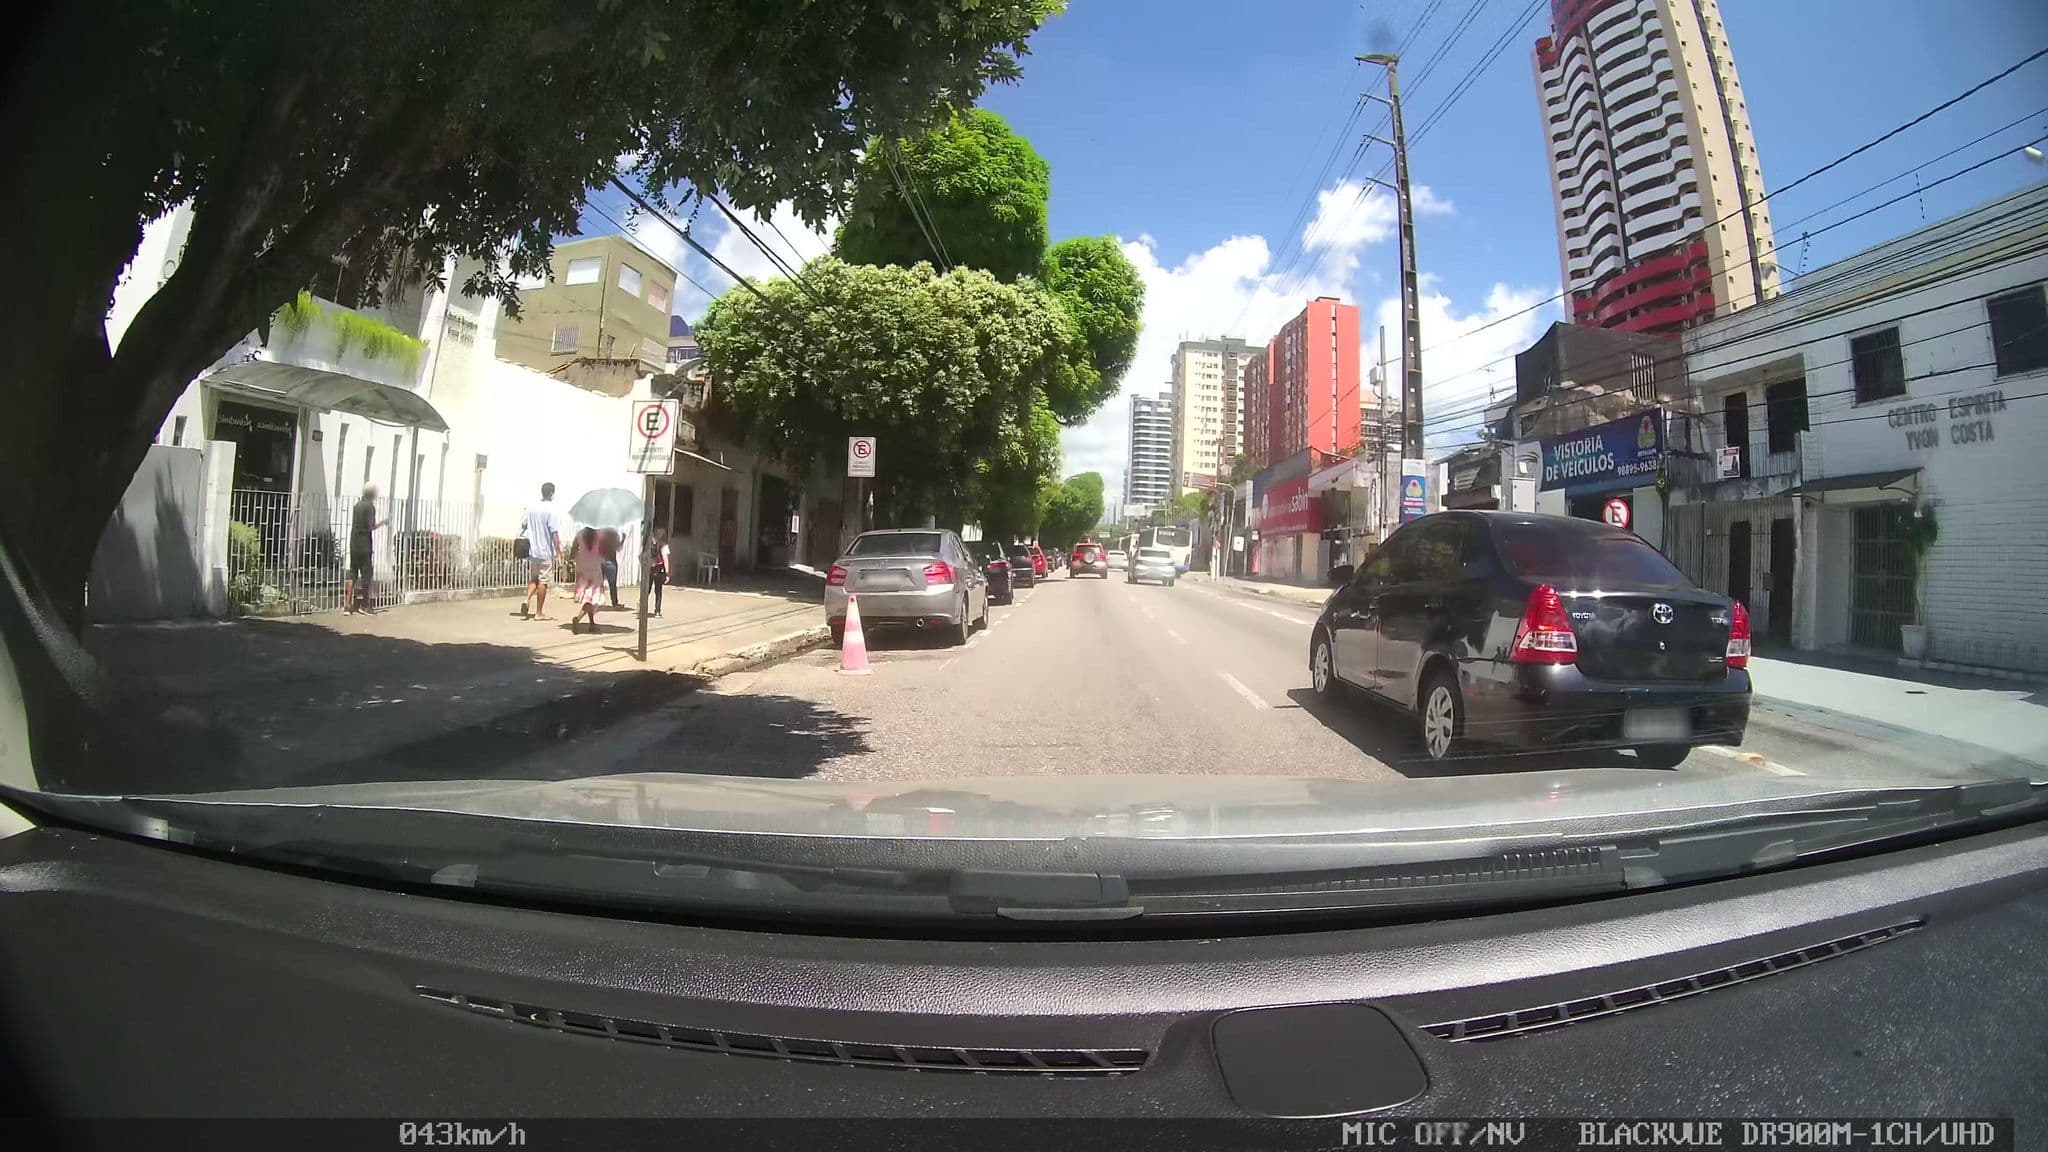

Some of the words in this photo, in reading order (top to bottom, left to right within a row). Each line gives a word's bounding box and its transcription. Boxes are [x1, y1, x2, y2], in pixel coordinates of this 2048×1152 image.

[647, 412, 659, 431] E
[1888, 403, 1936, 428] CENTRO
[1951, 420, 1995, 445] COSTA
[1553, 435, 1603, 460] VISTORIA
[1546, 465, 1559, 482] DE
